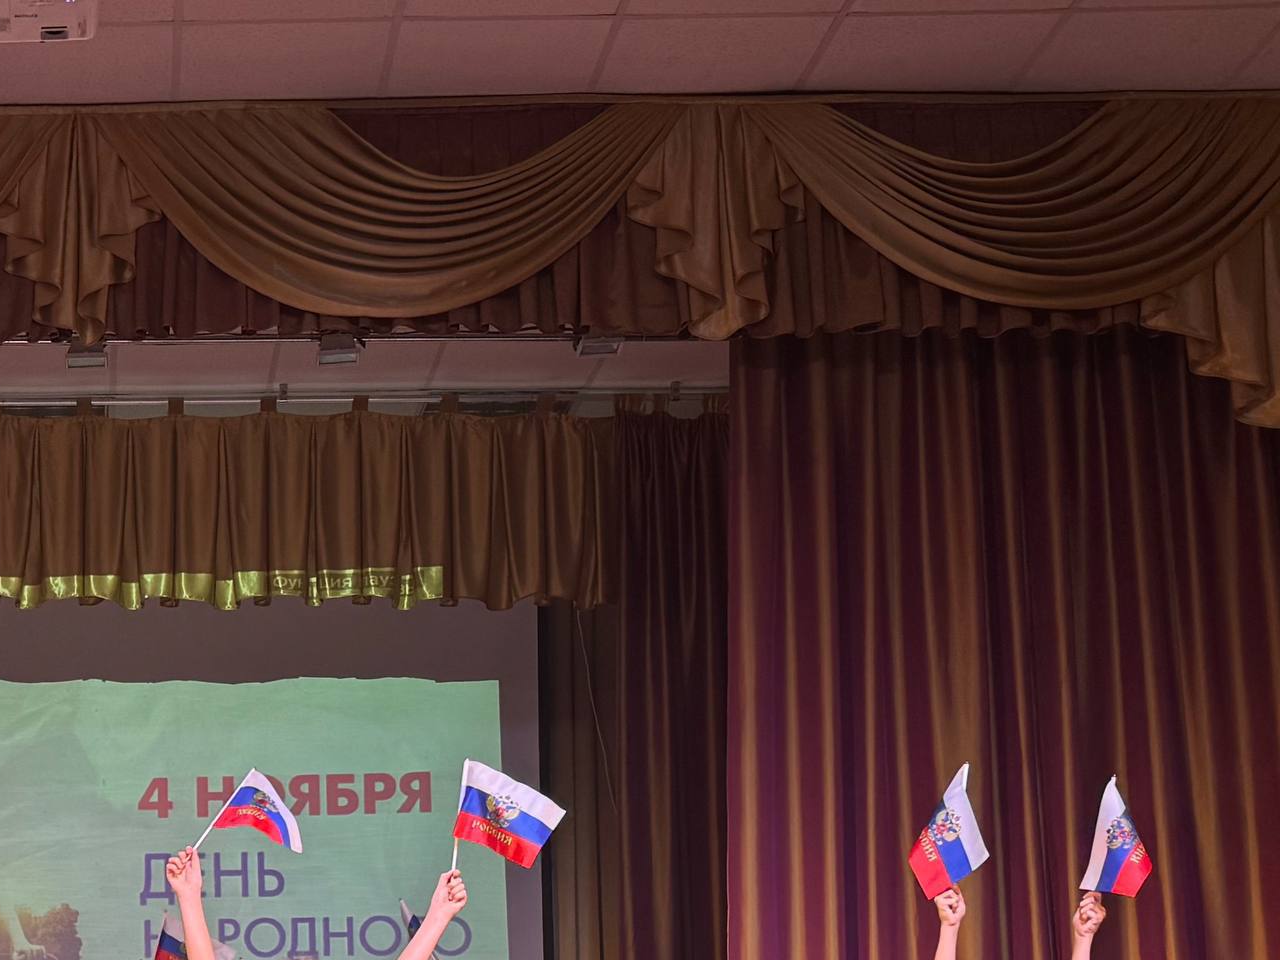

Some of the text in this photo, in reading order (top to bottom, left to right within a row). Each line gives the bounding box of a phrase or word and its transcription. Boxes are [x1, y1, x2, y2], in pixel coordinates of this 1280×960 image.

[138, 772, 432, 818] 4 НЯБРЯ
[140, 852, 285, 905] ДНЬ
[144, 915, 472, 960] РОДНОО
